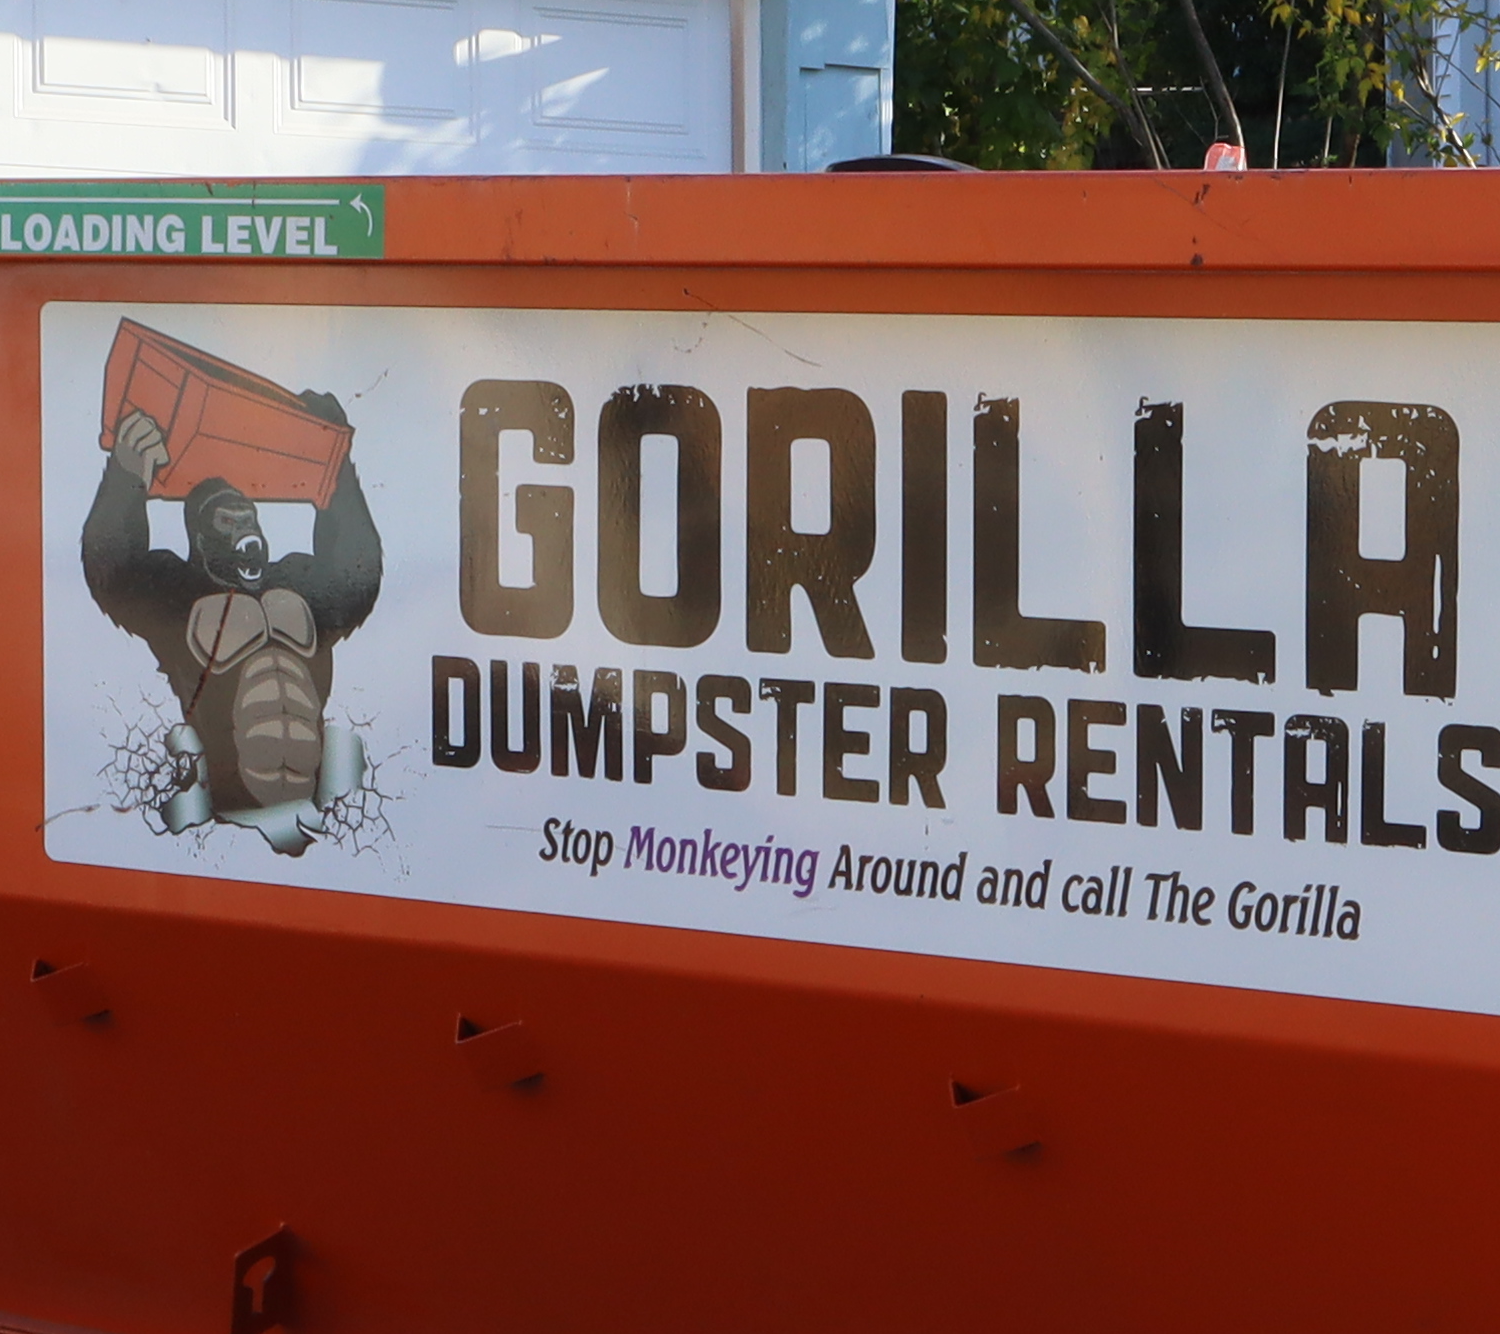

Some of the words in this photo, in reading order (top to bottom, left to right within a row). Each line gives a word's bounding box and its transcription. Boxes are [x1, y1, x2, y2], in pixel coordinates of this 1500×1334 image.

[0, 213, 185, 254] LOADING
[202, 216, 337, 256] LEVEL
[459, 379, 1460, 703] GORILLA
[431, 654, 947, 810] DUMPSTER
[539, 817, 614, 877] Stop
[623, 825, 819, 898] Monkeying
[828, 844, 968, 902] Around
[976, 859, 1053, 910] and
[1061, 865, 1133, 918] call
[1144, 871, 1215, 926] The
[1228, 881, 1362, 941] Gorilla
